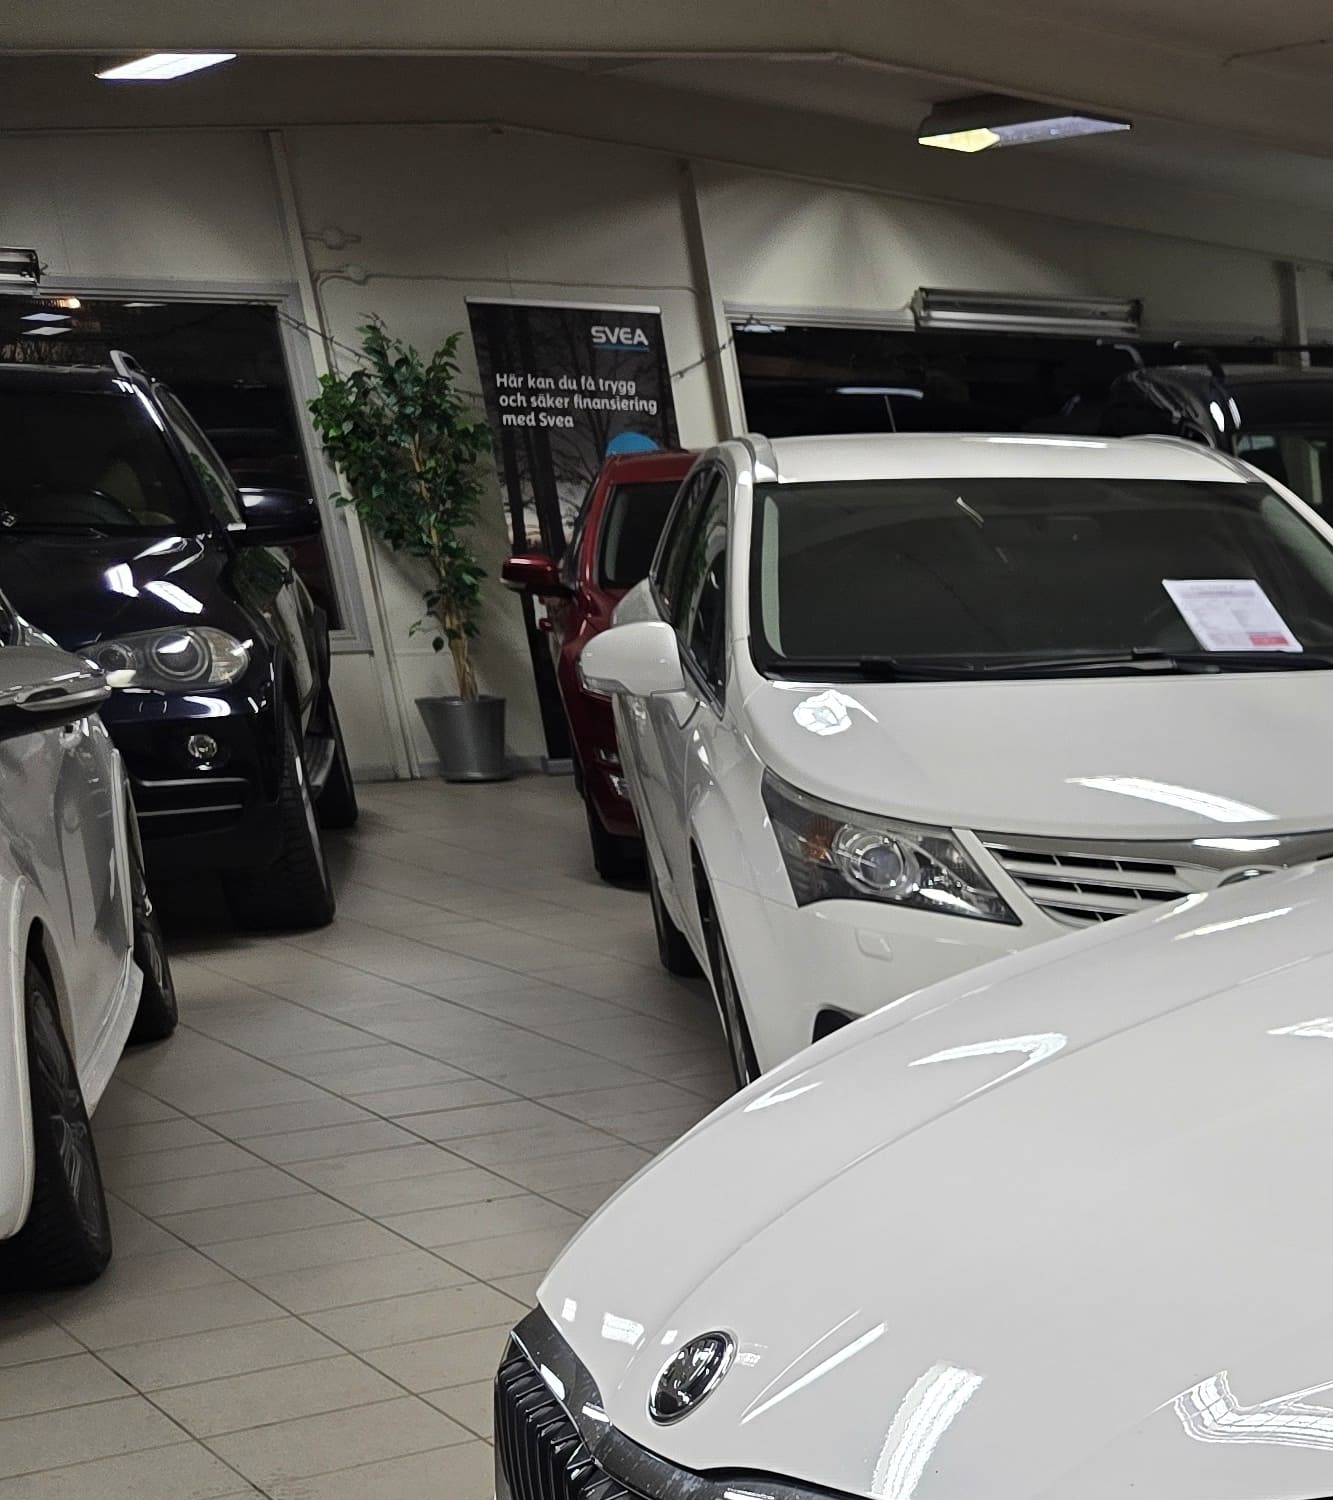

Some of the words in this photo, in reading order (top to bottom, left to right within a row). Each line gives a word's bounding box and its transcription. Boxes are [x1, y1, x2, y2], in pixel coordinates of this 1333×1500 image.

[591, 326, 648, 345] SVEA
[496, 373, 523, 388] Här
[528, 374, 554, 389] kan
[559, 374, 577, 390] du
[581, 375, 595, 391] få
[599, 377, 636, 396] trygg
[499, 393, 527, 408] och
[531, 393, 569, 409] säker
[573, 394, 657, 415] finansiering
[502, 412, 536, 427] med
[538, 413, 574, 428] Svea
